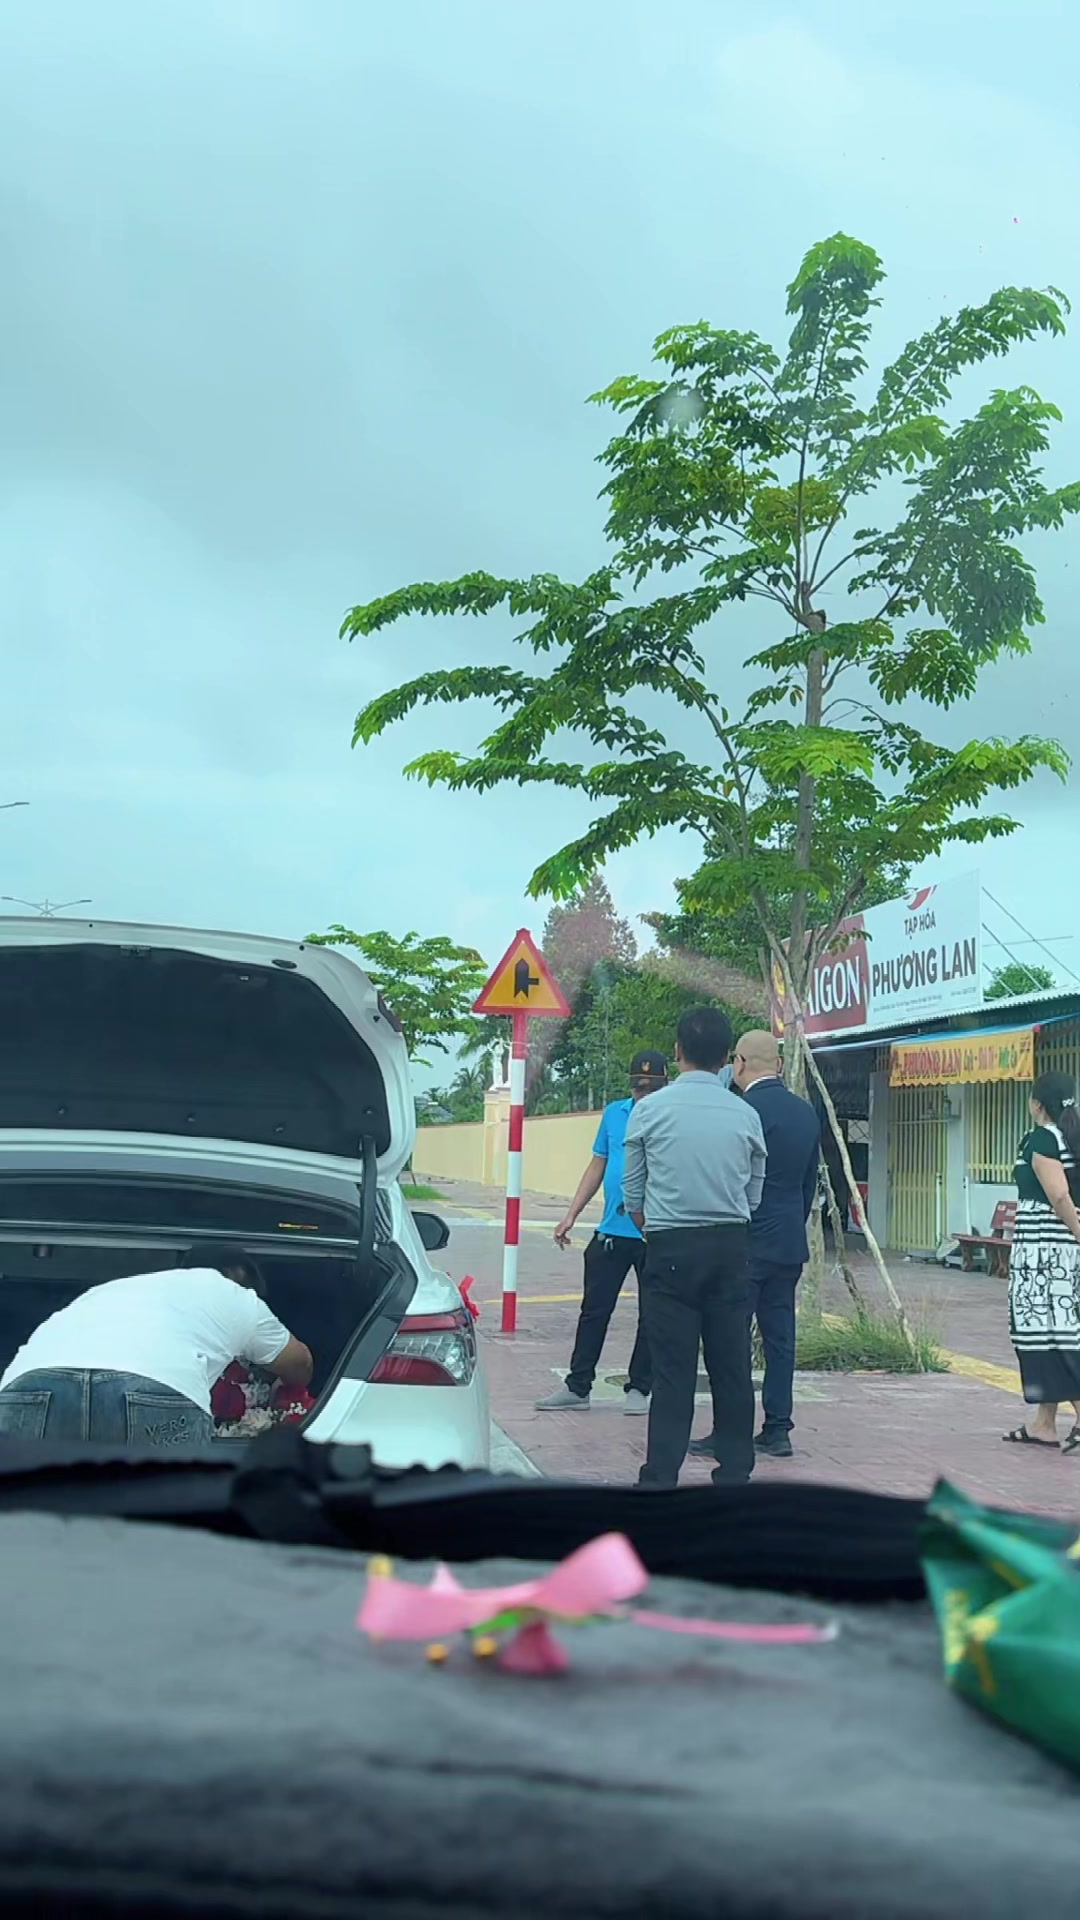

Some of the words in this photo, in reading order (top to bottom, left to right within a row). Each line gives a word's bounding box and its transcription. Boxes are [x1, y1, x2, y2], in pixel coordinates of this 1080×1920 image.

[904, 915, 918, 940] TẠP
[919, 908, 936, 931] HÓA
[872, 948, 938, 997] PHƯƠNG
[942, 937, 976, 981] LAN
